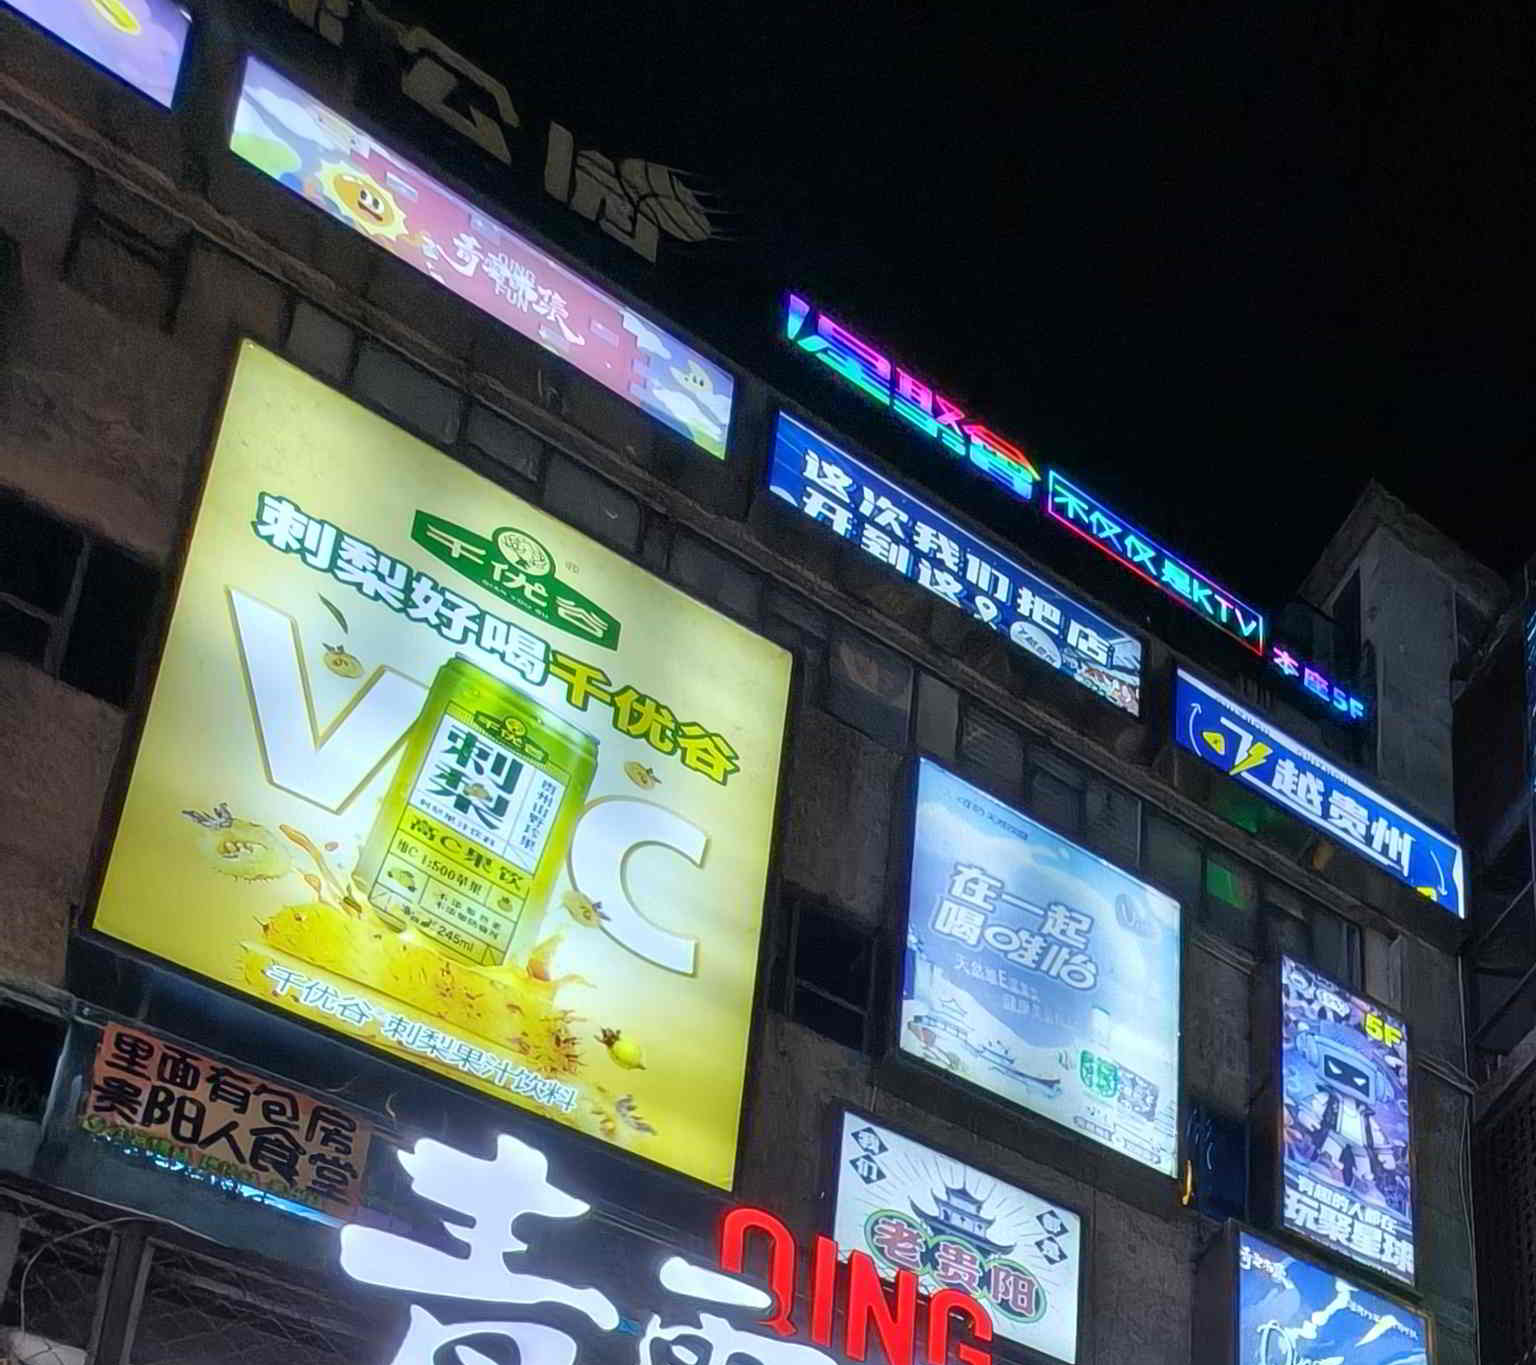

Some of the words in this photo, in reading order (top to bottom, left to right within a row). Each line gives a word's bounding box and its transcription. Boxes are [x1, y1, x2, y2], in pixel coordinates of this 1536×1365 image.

[425, 521, 610, 638] 千优谷
[801, 486, 968, 609] 开到这
[802, 448, 1118, 666] 这次我们把店
[1052, 483, 1258, 640] 不仅仅是KTV
[949, 863, 1094, 950] 在一起
[266, 961, 373, 1028] 千优谷
[383, 1010, 577, 1113] 刺梨果汁饮料
[1365, 1011, 1402, 1048] 5F
[93, 1074, 358, 1205] 贵阳人食堂
[105, 1031, 357, 1158] 里面有包房
[872, 1216, 1036, 1317] 老贵阳
